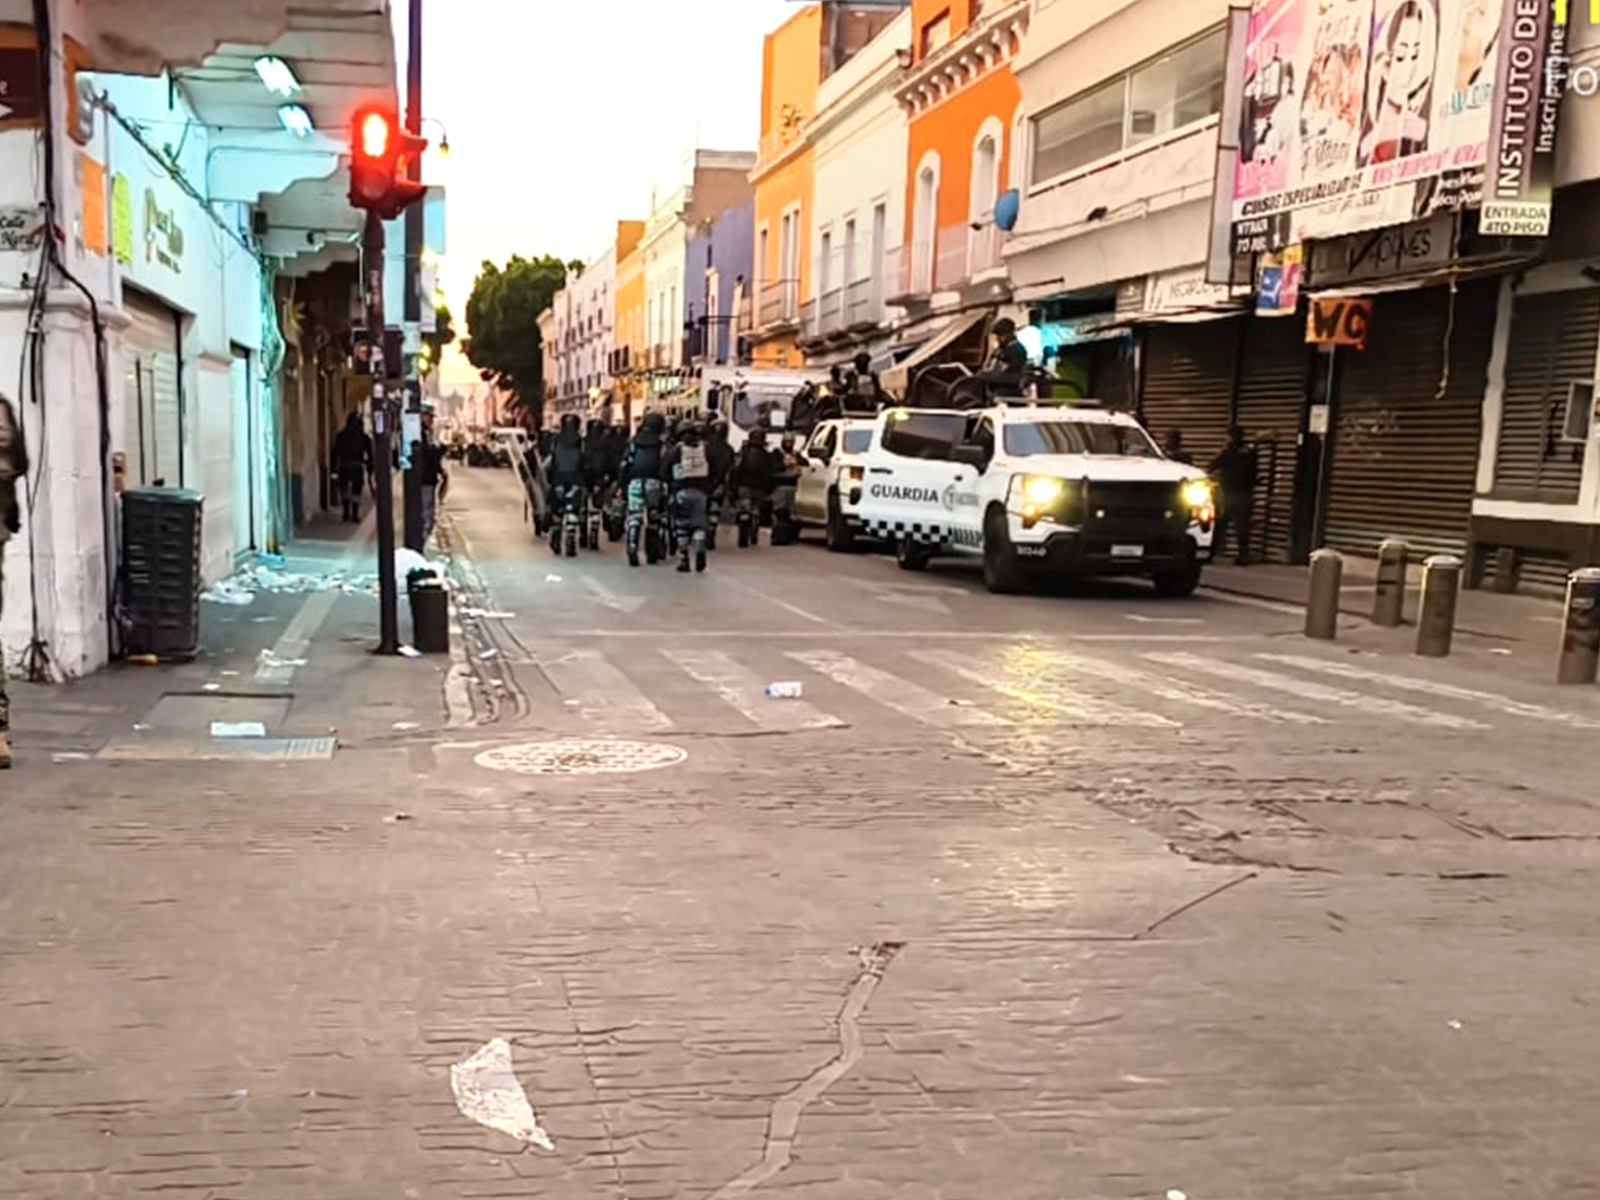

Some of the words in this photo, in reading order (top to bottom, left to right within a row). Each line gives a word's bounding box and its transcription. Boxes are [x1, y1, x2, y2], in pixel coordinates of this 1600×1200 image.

[1513, 0, 1539, 38] DE
[1497, 45, 1534, 197] INSTITUTO
[1484, 206, 1547, 220] ENTRADA
[1485, 222, 1511, 233] 4TO
[1514, 222, 1545, 233] PISO
[1313, 300, 1366, 339] WC
[870, 484, 939, 503] GUARDIA
